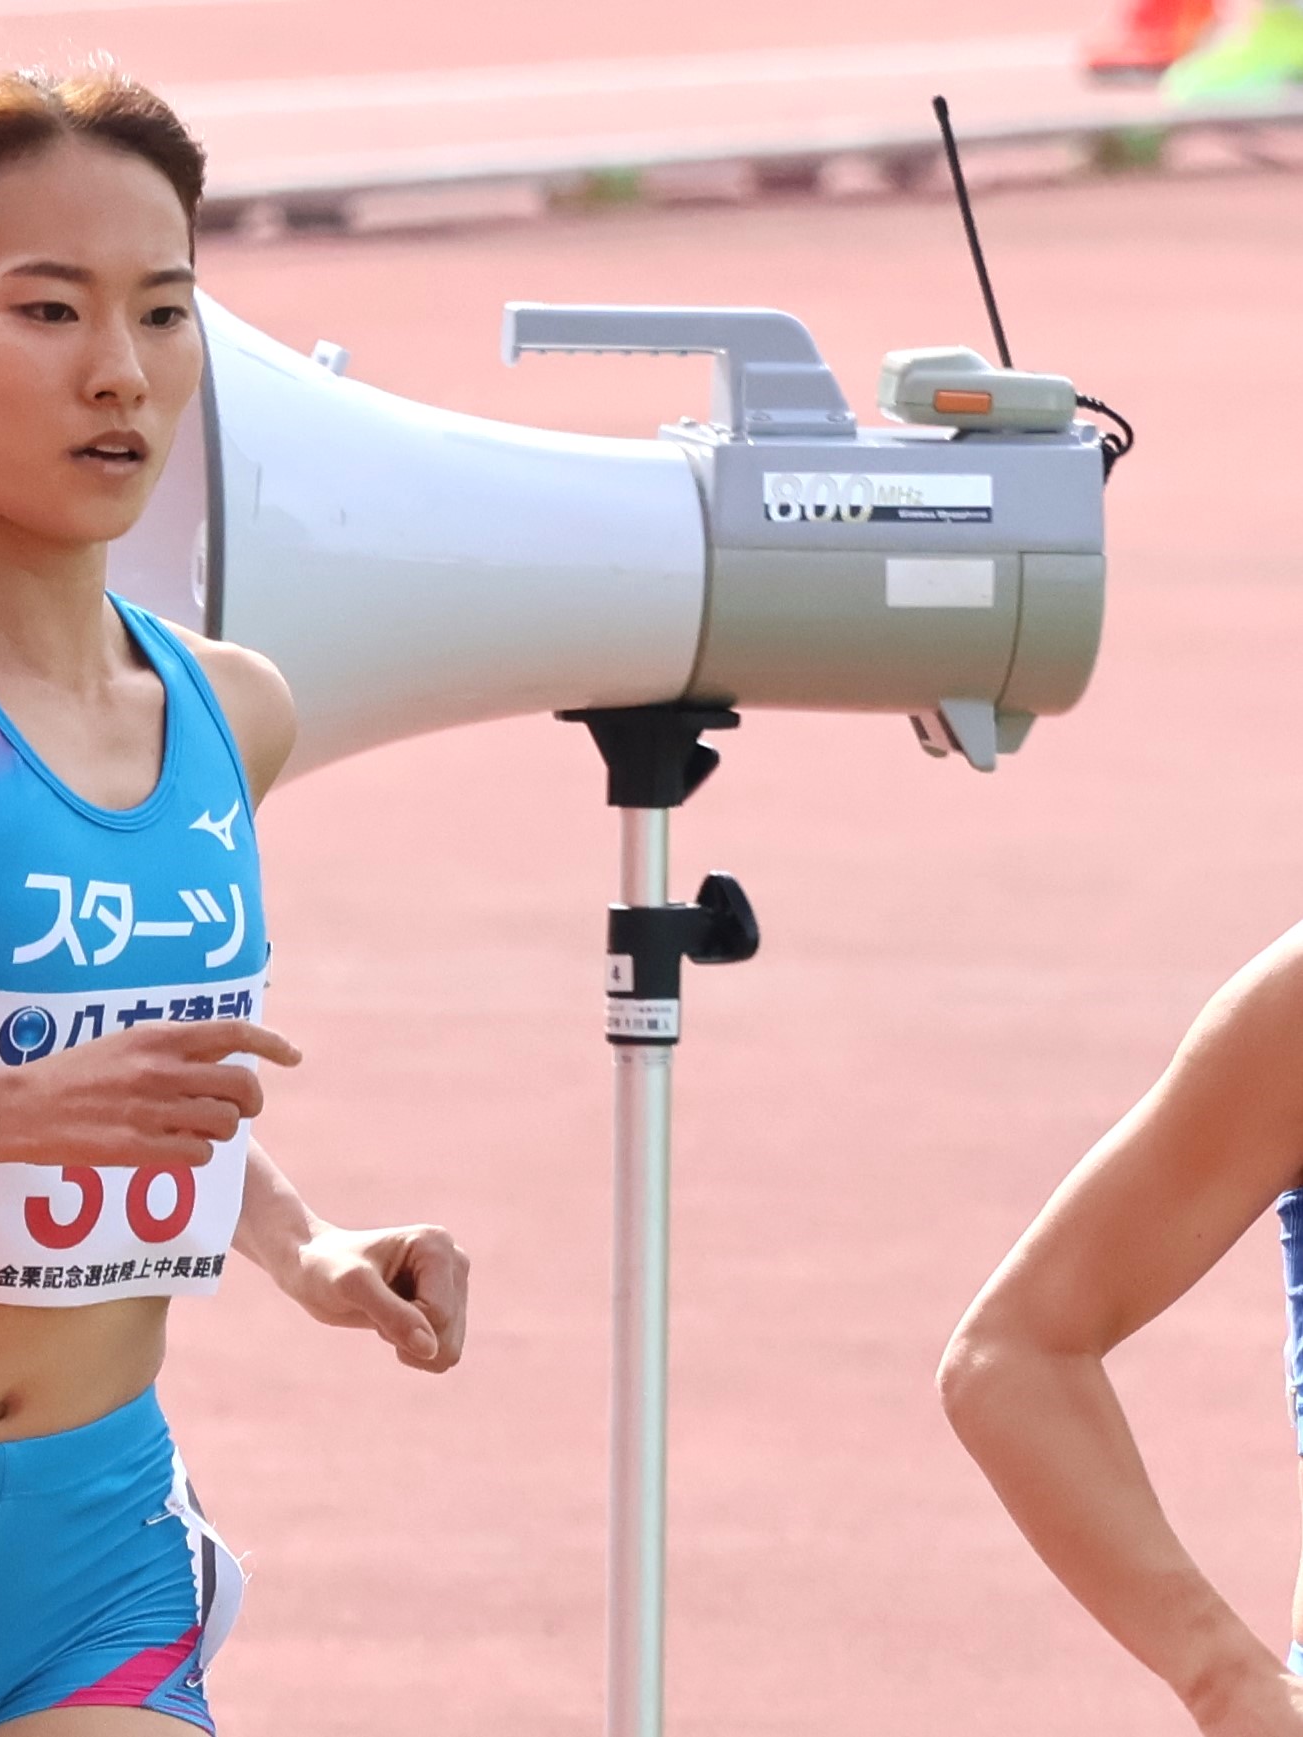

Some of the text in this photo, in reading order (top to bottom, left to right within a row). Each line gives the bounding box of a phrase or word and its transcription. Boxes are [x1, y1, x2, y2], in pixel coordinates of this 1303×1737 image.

[767, 473, 875, 523] 800
[877, 484, 924, 506] MHz
[12, 873, 246, 969] スターツ
